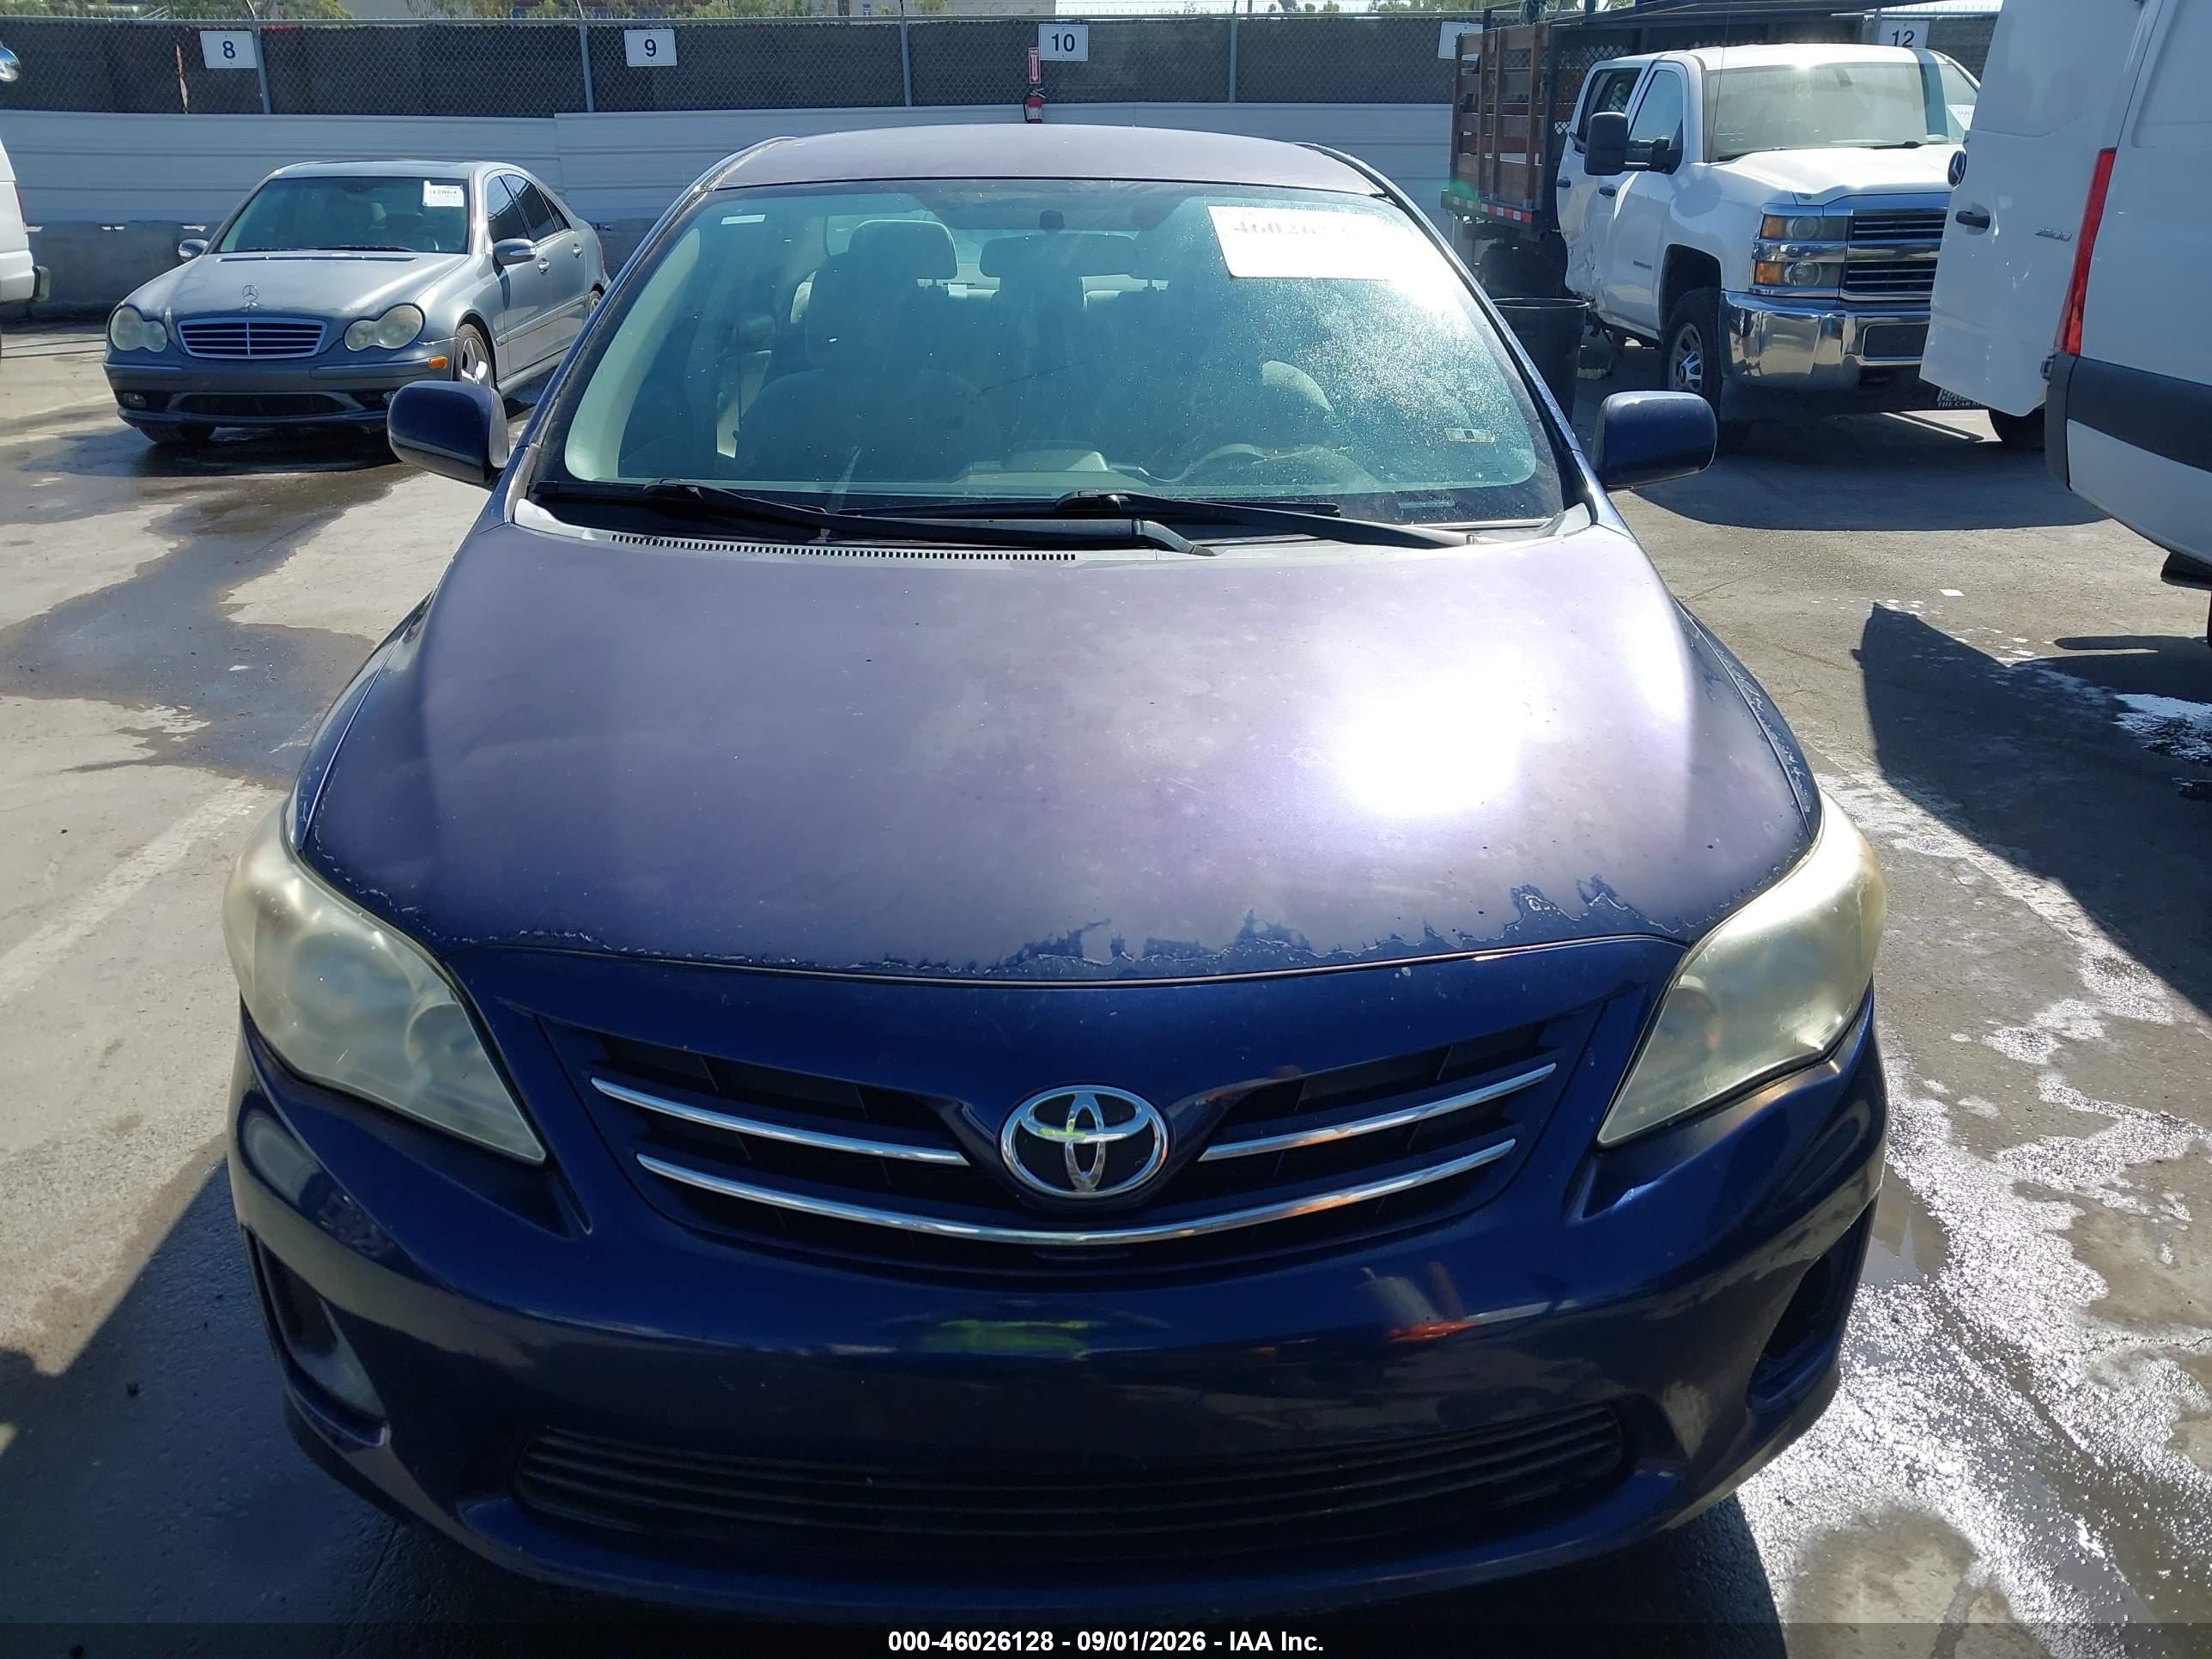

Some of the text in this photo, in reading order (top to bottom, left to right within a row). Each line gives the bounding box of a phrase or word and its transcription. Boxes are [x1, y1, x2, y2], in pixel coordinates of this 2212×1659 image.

[1052, 33, 1075, 52] 10
[1892, 30, 1914, 48] 12
[222, 41, 235, 59] 8
[644, 39, 657, 58] 9
